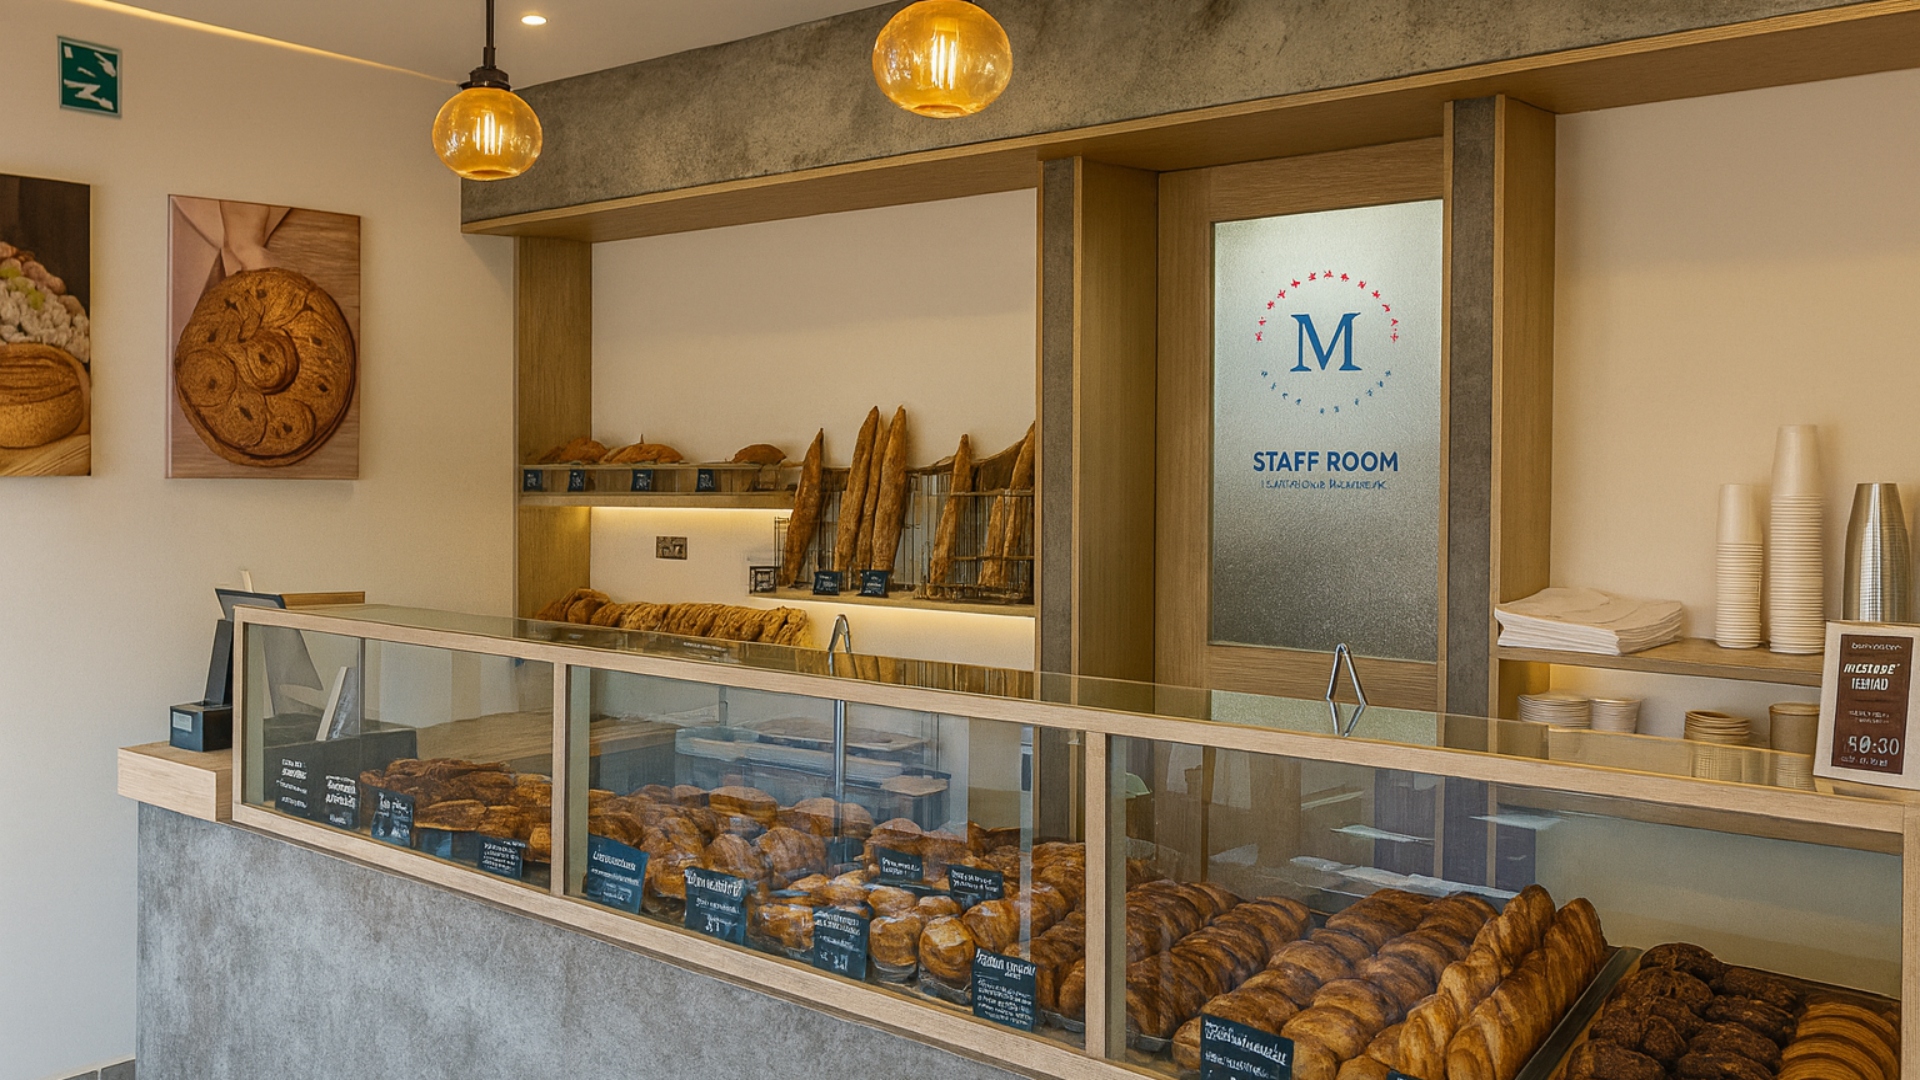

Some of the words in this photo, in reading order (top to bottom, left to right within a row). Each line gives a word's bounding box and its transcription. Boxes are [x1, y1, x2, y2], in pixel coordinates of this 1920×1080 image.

[1290, 312, 1362, 372] M
[1253, 451, 1320, 472] STAFF
[1327, 451, 1399, 472] ROOM
